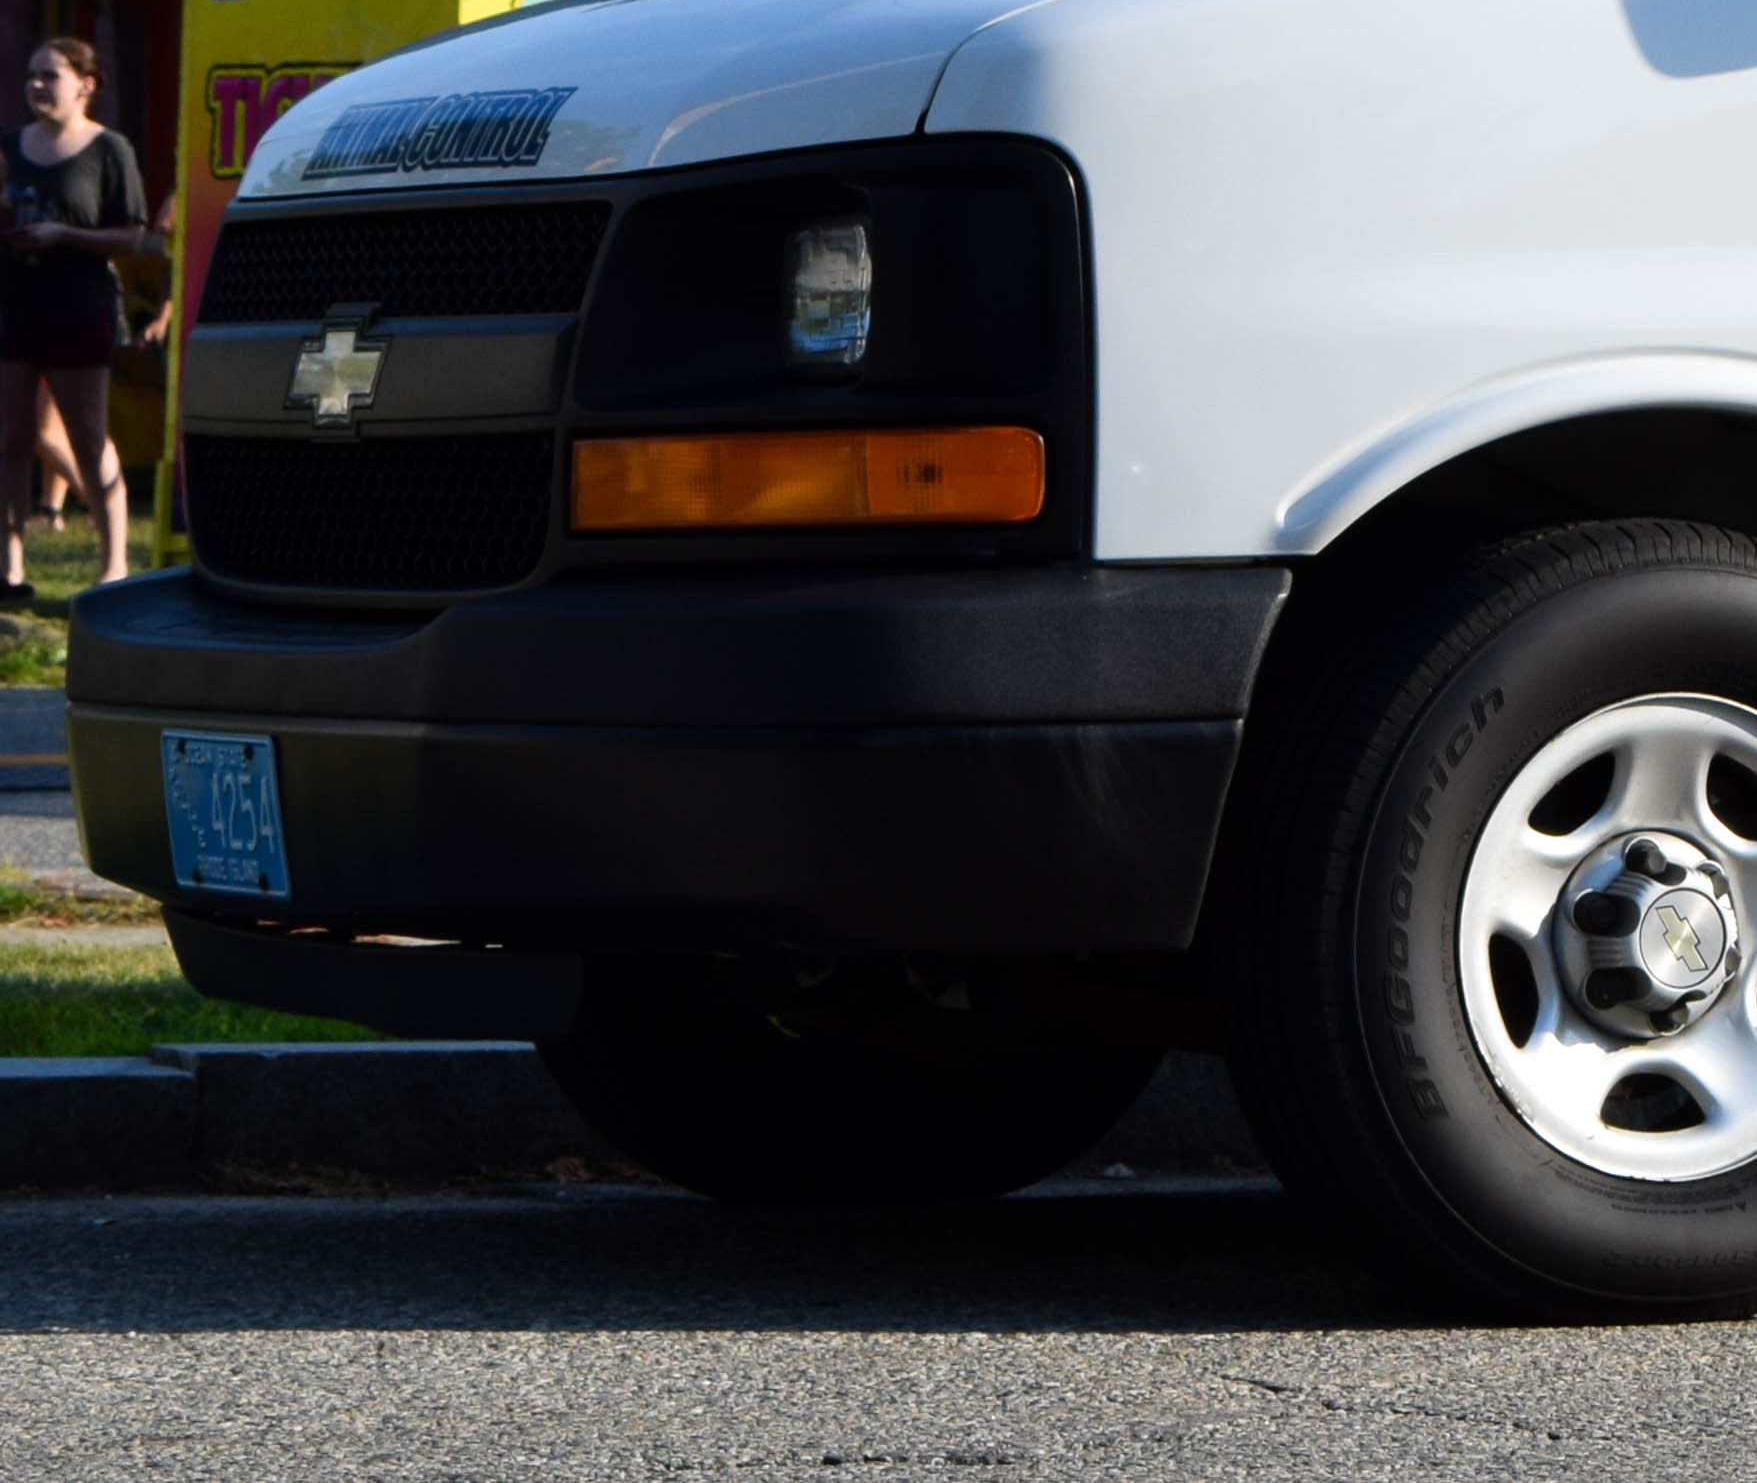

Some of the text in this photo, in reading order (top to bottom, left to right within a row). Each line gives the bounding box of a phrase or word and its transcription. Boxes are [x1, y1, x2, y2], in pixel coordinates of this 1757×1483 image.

[303, 89, 575, 178] ANIMAL CONTROL
[1384, 684, 1505, 1119] BFGoodrich
